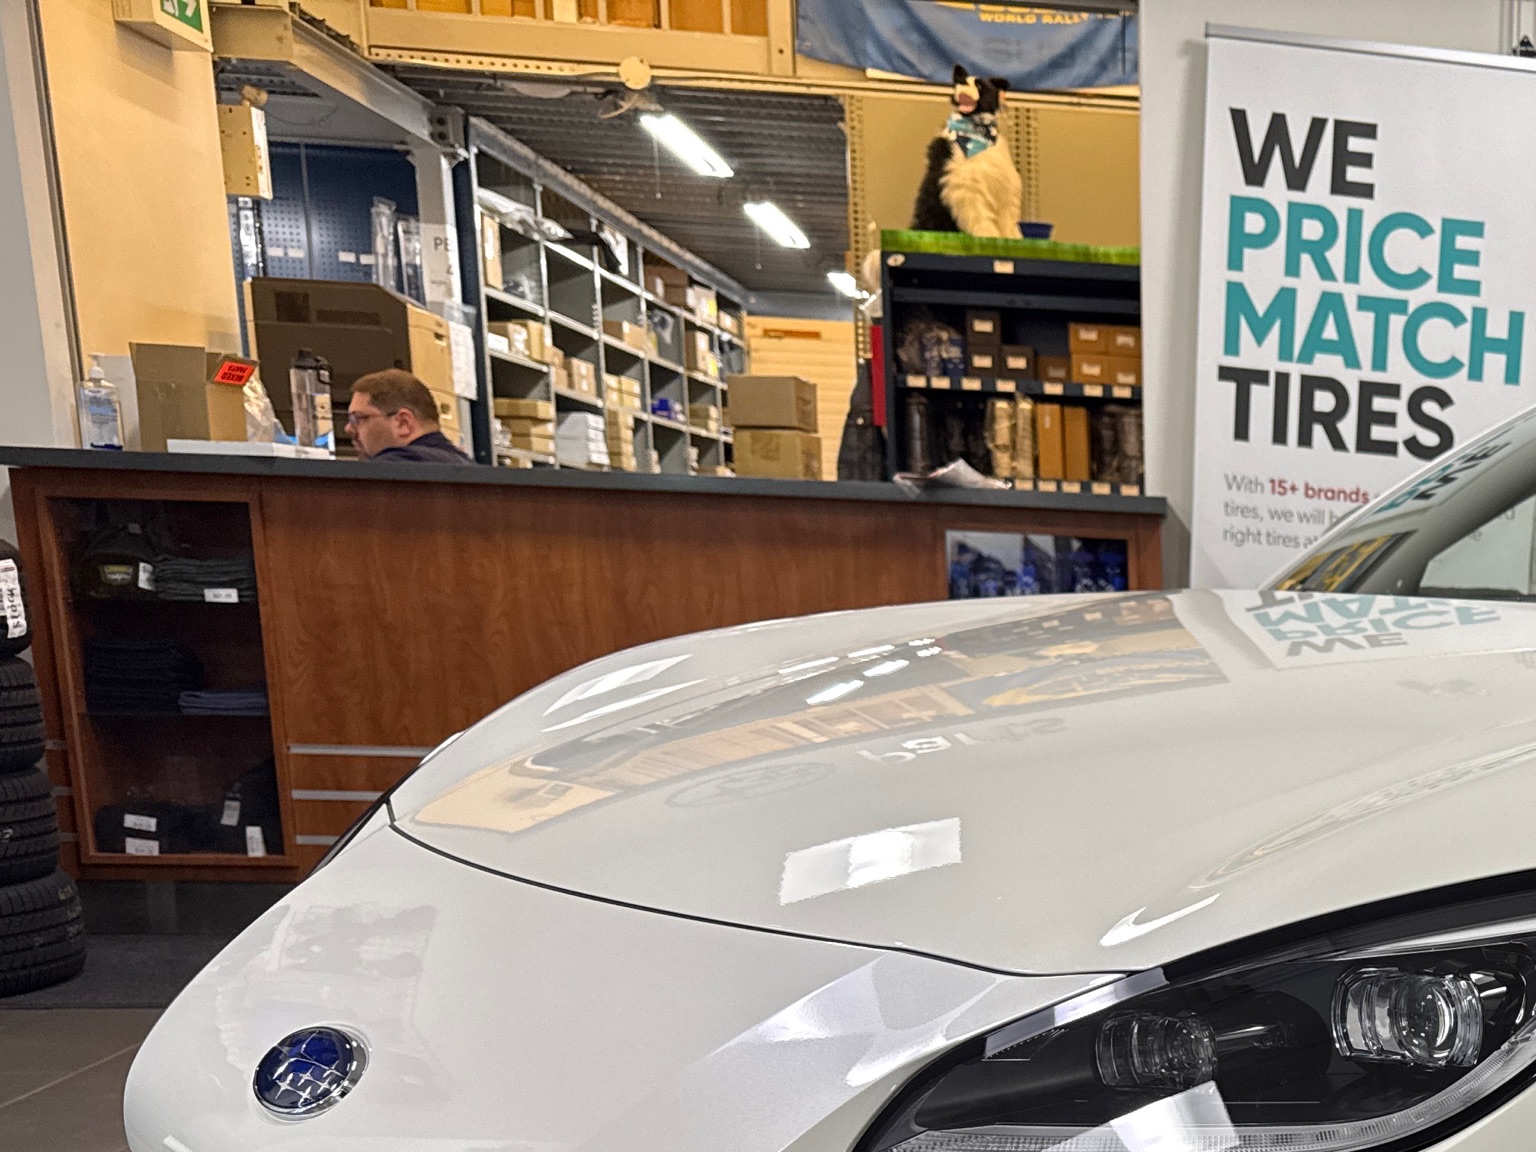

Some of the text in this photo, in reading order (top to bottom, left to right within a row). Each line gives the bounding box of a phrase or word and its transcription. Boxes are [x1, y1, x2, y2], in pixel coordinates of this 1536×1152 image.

[978, 12, 1037, 24] WORLD
[1041, 13, 1090, 25] RALLY
[1229, 107, 1379, 200] WE
[1227, 194, 1486, 297] PRICE
[1223, 280, 1525, 386] MATCH
[1218, 364, 1456, 462] TIRES
[1223, 472, 1371, 504] With 15+ brands
[1223, 501, 1264, 523] tires,
[1268, 509, 1295, 523] we
[1299, 506, 1326, 525] will
[1223, 525, 1263, 548] right
[1266, 531, 1300, 549] tires
